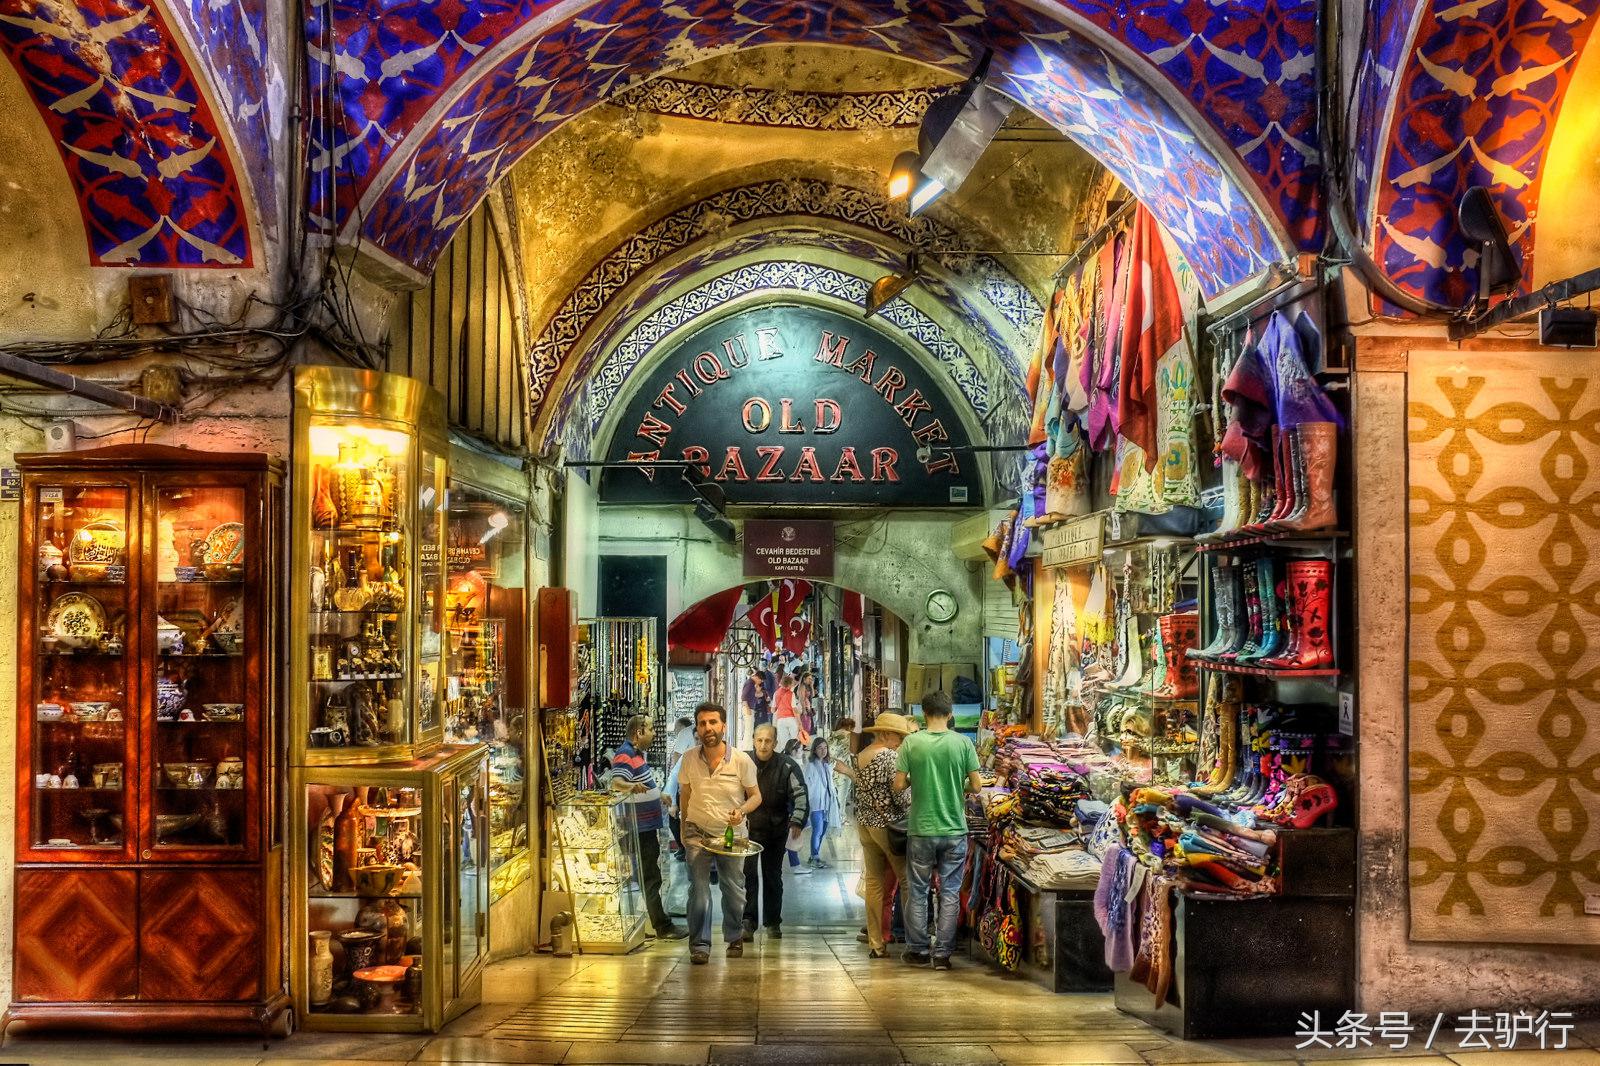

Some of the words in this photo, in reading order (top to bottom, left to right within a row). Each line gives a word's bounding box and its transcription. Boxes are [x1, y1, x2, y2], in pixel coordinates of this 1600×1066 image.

[627, 327, 784, 482] ANTIQUE
[814, 330, 960, 475] MARKET
[742, 396, 842, 433] OLD
[682, 446, 900, 482] BAZAAR
[756, 547, 784, 555] CEVAHİR
[785, 547, 821, 556] BEDESTENİ
[782, 557, 809, 565] BAZAAR
